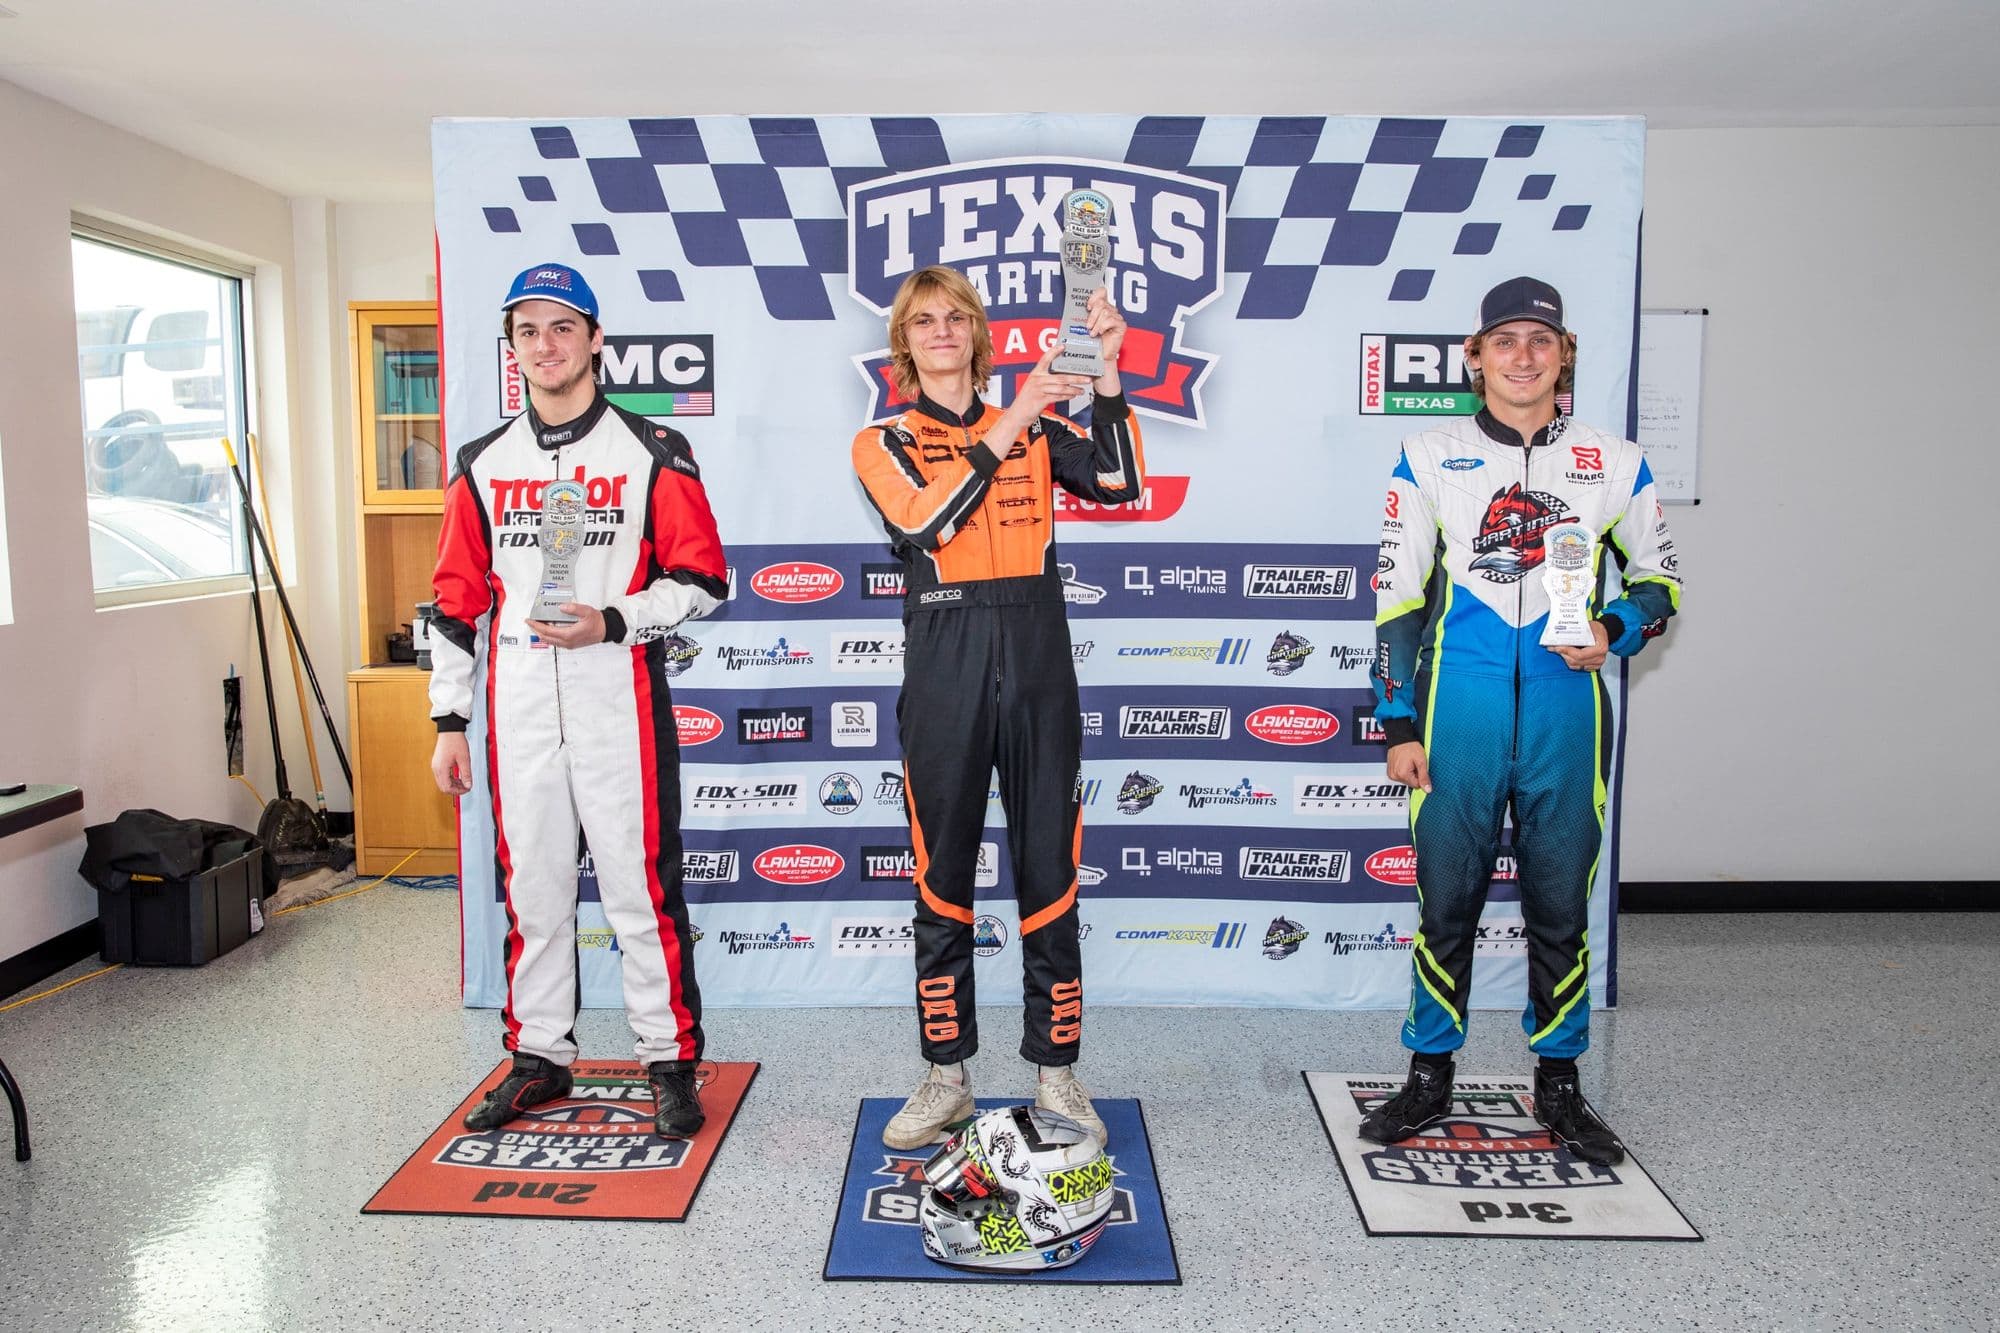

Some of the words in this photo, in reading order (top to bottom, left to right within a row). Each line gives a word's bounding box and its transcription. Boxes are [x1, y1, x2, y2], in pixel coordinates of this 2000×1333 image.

[535, 271, 561, 281] FOX
[601, 343, 706, 385] MC
[1366, 344, 1380, 407] ROTAX
[1392, 397, 1456, 409] TEXAS
[542, 430, 572, 443] freem
[1565, 471, 1605, 480] LEBARO
[511, 511, 541, 526] kar
[584, 510, 617, 524] ech
[1474, 512, 1560, 550] KARTING
[585, 531, 616, 546] ON
[757, 573, 836, 587] LAWSON
[1160, 565, 1227, 590] alpha
[1256, 570, 1334, 582] TRAILER-
[867, 573, 904, 595] Tray
[1186, 585, 1227, 594] TIMING
[1262, 582, 1333, 595] ALARMS
[1336, 572, 1346, 594] .COM
[920, 589, 962, 602] sparco
[718, 646, 767, 659] MOSLEY
[840, 640, 885, 653] FOX
[1330, 645, 1377, 658] MOSLE
[1118, 646, 1221, 661] COMPKART
[726, 655, 814, 671] MOTORSPORTS
[1132, 710, 1209, 723] TRAILER-
[1211, 711, 1222, 734] .COM
[743, 711, 806, 740] Traylor
[1139, 723, 1206, 735] ALARMS
[1251, 717, 1332, 730] LAWSON
[753, 732, 771, 740] kart
[782, 730, 802, 738] tech
[1083, 727, 1103, 736] ING
[696, 784, 739, 799] FOX
[753, 783, 798, 797] SON
[1179, 784, 1230, 796] MOSLEY
[1303, 784, 1348, 797] FOX
[1362, 784, 1407, 797] SON
[1187, 796, 1278, 808] MOTORSPORTS
[759, 856, 837, 868] LAWSON
[1156, 847, 1223, 871] alpha
[1252, 851, 1327, 864] TRAILER-
[1183, 866, 1222, 875] TIMING
[1258, 864, 1326, 878] ALARMS
[1330, 854, 1340, 878] .COM
[719, 930, 769, 943] MOSLEY
[841, 925, 882, 938] FOX
[1115, 929, 1217, 944] COMPKART
[1325, 932, 1375, 943] MOSLEY
[728, 940, 815, 955] MOTORSPORTS
[1333, 942, 1414, 955] MOTORSPORT
[526, 1123, 638, 1133] LEAGUE
[501, 1133, 649, 1147] KARTING
[1416, 1138, 1534, 1149] LEAGUE
[450, 1140, 675, 1170] TEXAS
[1404, 1150, 1559, 1165] KARTING
[1374, 1157, 1614, 1187] TEXAS
[472, 1181, 598, 1205] 2nd
[1460, 1200, 1573, 1224] 3rd
[954, 1243, 982, 1256] Friend
